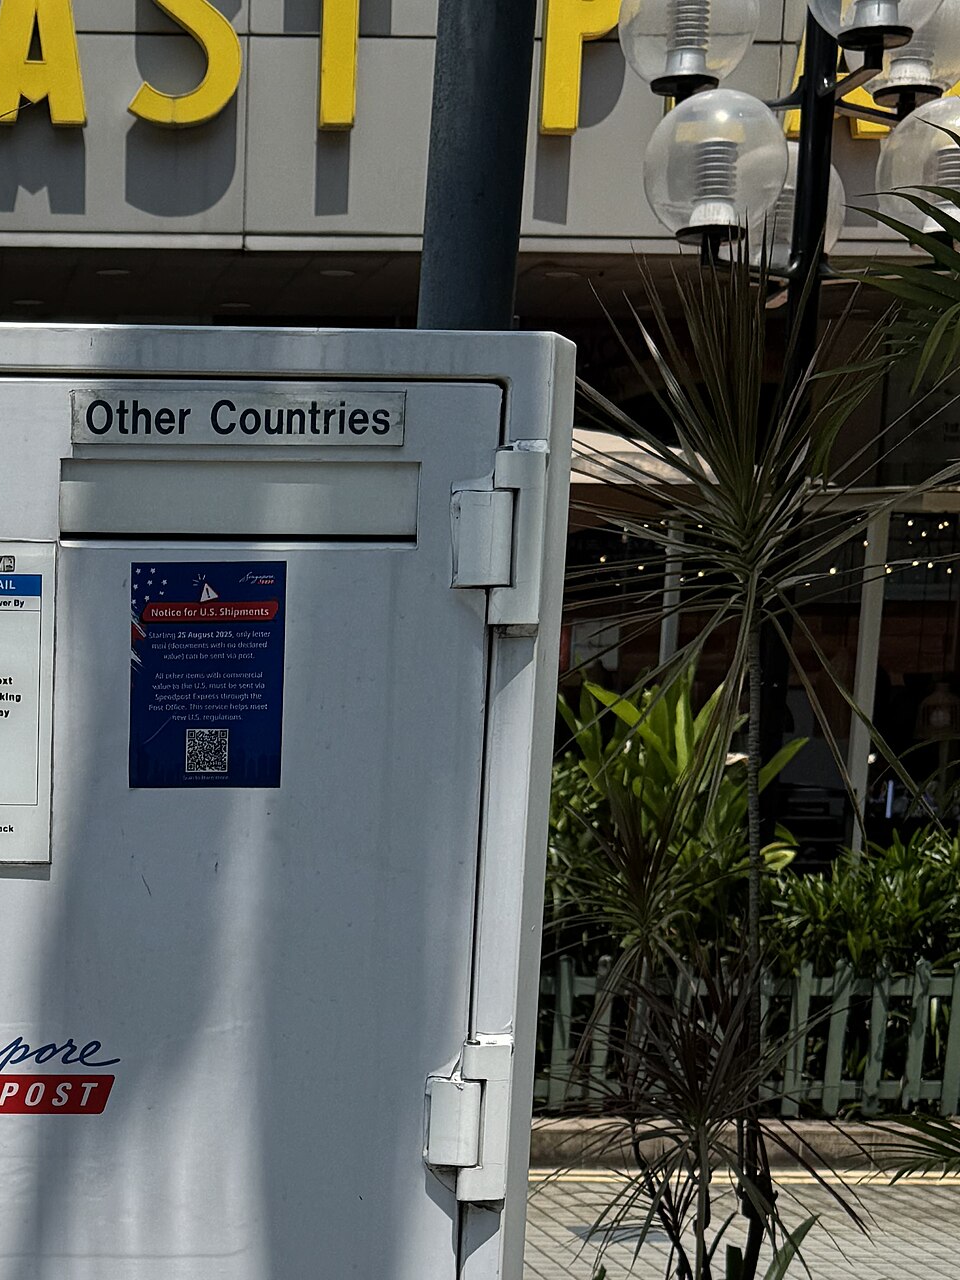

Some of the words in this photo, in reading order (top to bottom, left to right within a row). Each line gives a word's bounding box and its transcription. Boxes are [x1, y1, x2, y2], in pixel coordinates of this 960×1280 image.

[86, 400, 191, 435] Other
[210, 400, 390, 435] Countries
[14, 599, 25, 608] By
[151, 608, 182, 617] Notice
[183, 608, 198, 617] for
[199, 608, 218, 617] U.S.
[219, 607, 269, 618] Shipments
[177, 631, 186, 639] 25
[187, 631, 214, 640] August
